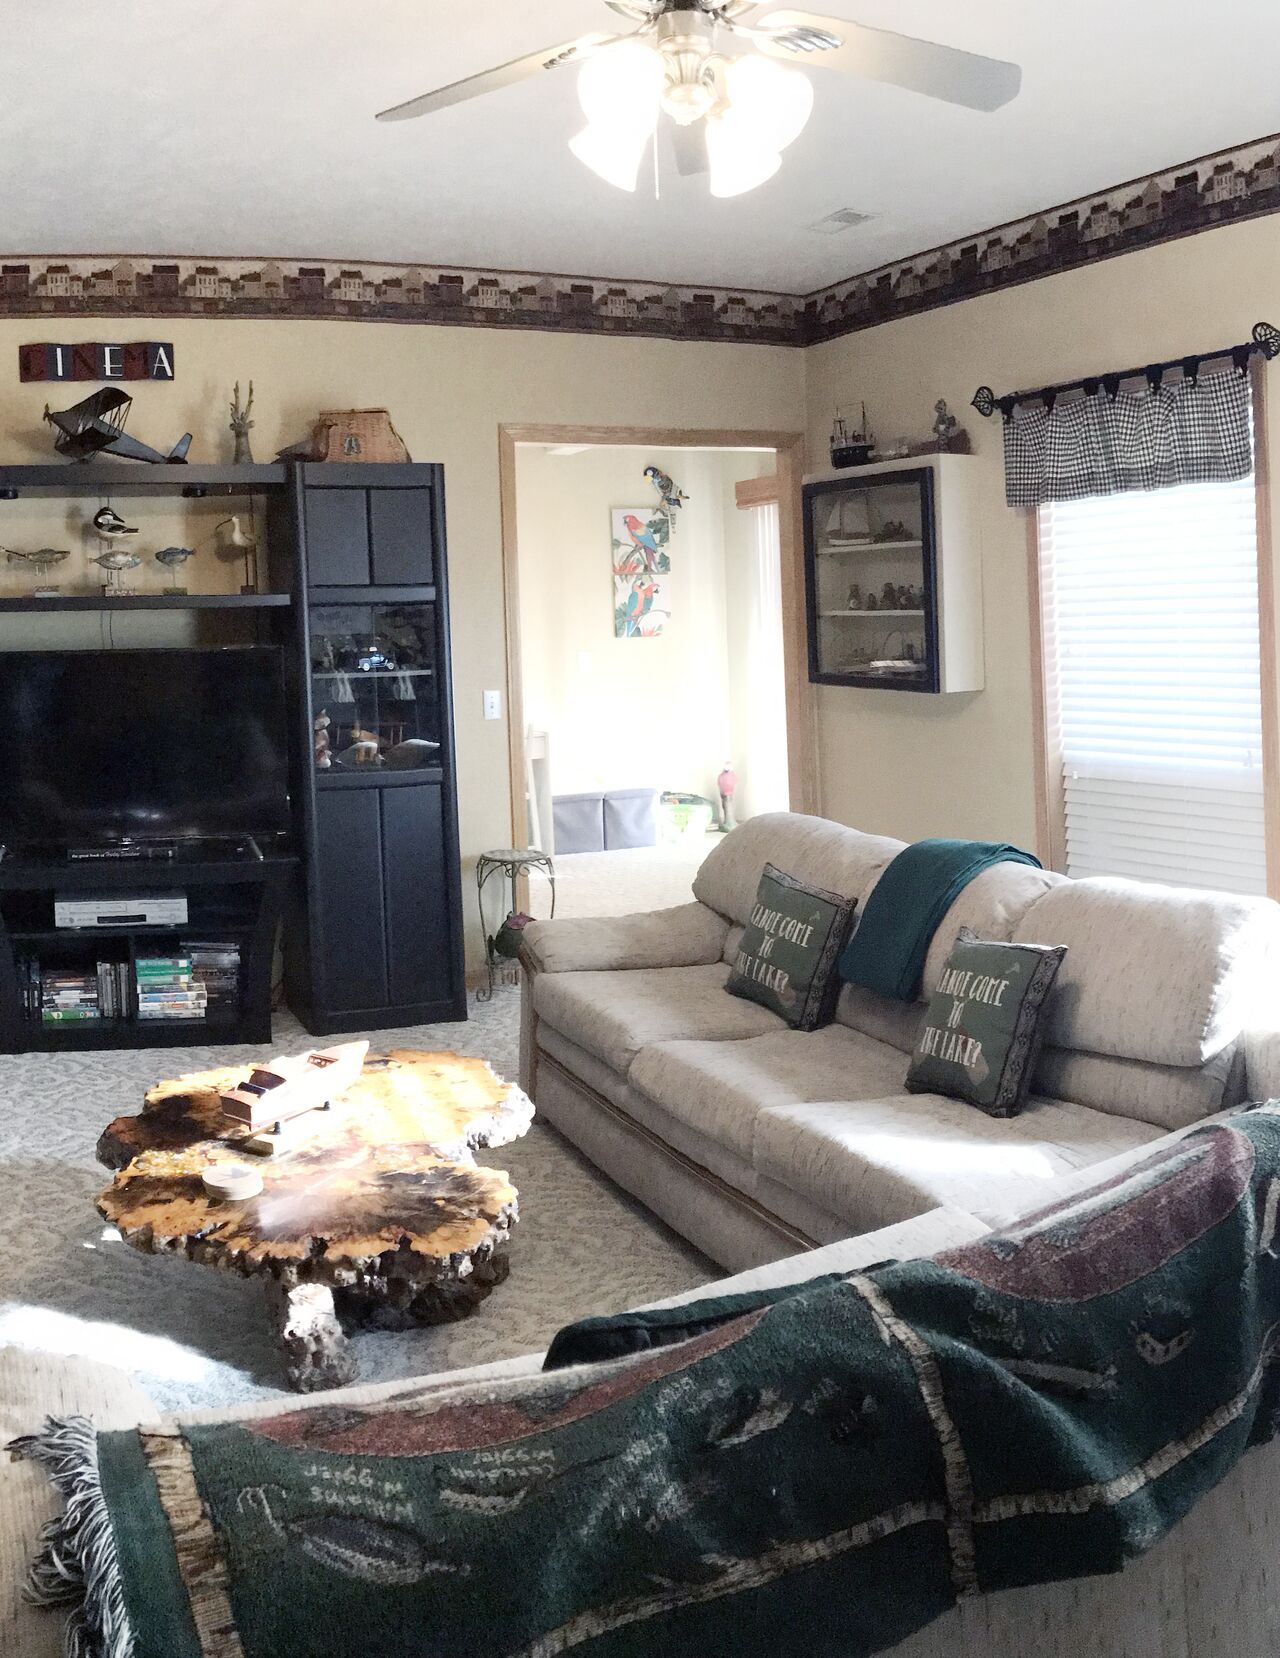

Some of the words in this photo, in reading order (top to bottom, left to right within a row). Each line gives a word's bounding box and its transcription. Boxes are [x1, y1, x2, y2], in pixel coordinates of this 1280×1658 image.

[750, 903, 783, 934] CANOE
[778, 917, 814, 948] COME
[758, 935, 775, 958] TO
[968, 975, 1010, 1007] COME
[947, 1001, 965, 1029] TO
[920, 1027, 942, 1057] THE
[939, 1031, 983, 1068] LAKE?
